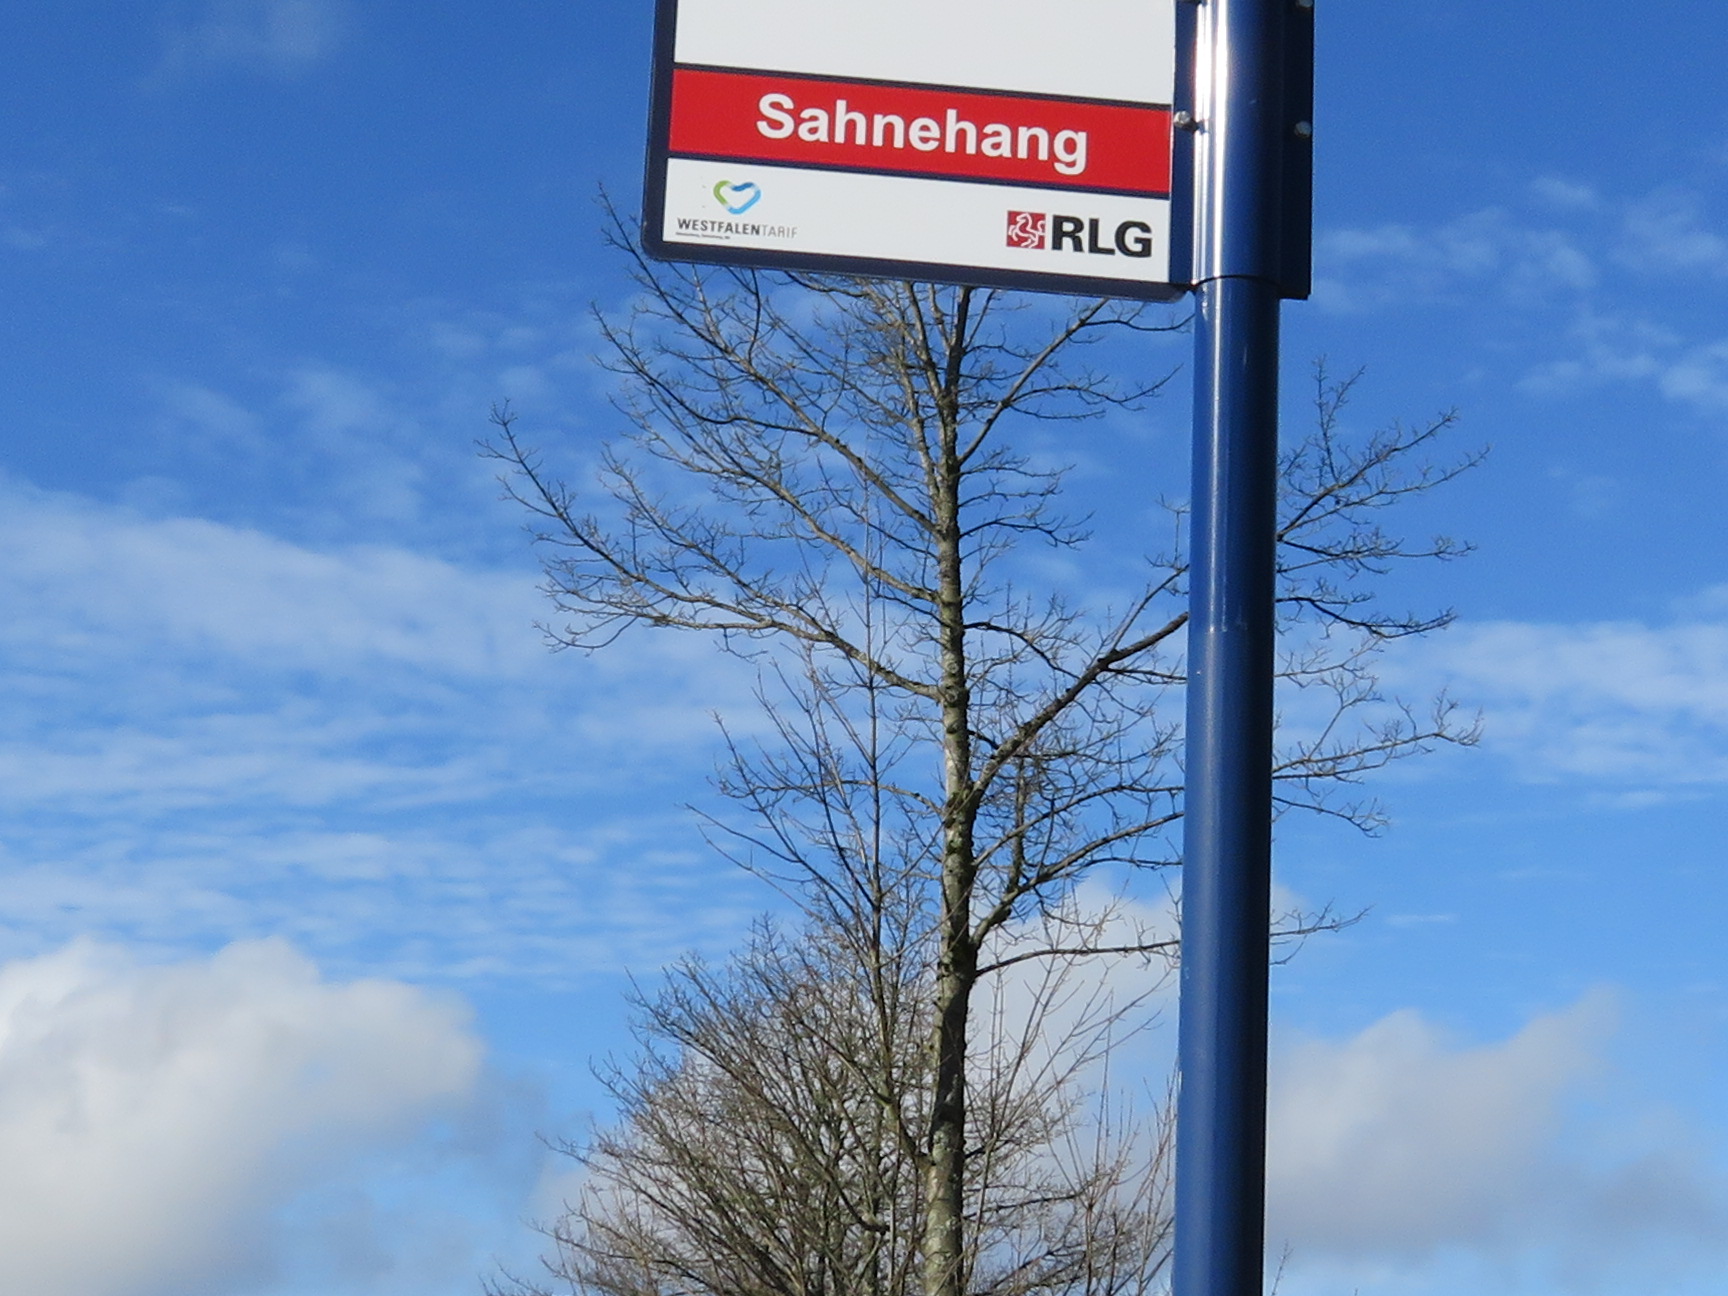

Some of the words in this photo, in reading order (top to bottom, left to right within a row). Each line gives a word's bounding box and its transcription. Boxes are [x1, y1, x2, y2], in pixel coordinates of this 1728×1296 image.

[756, 92, 1087, 174] Sahnehang
[677, 217, 798, 238] WESTFALENTARIF
[1051, 214, 1152, 257] RLG
